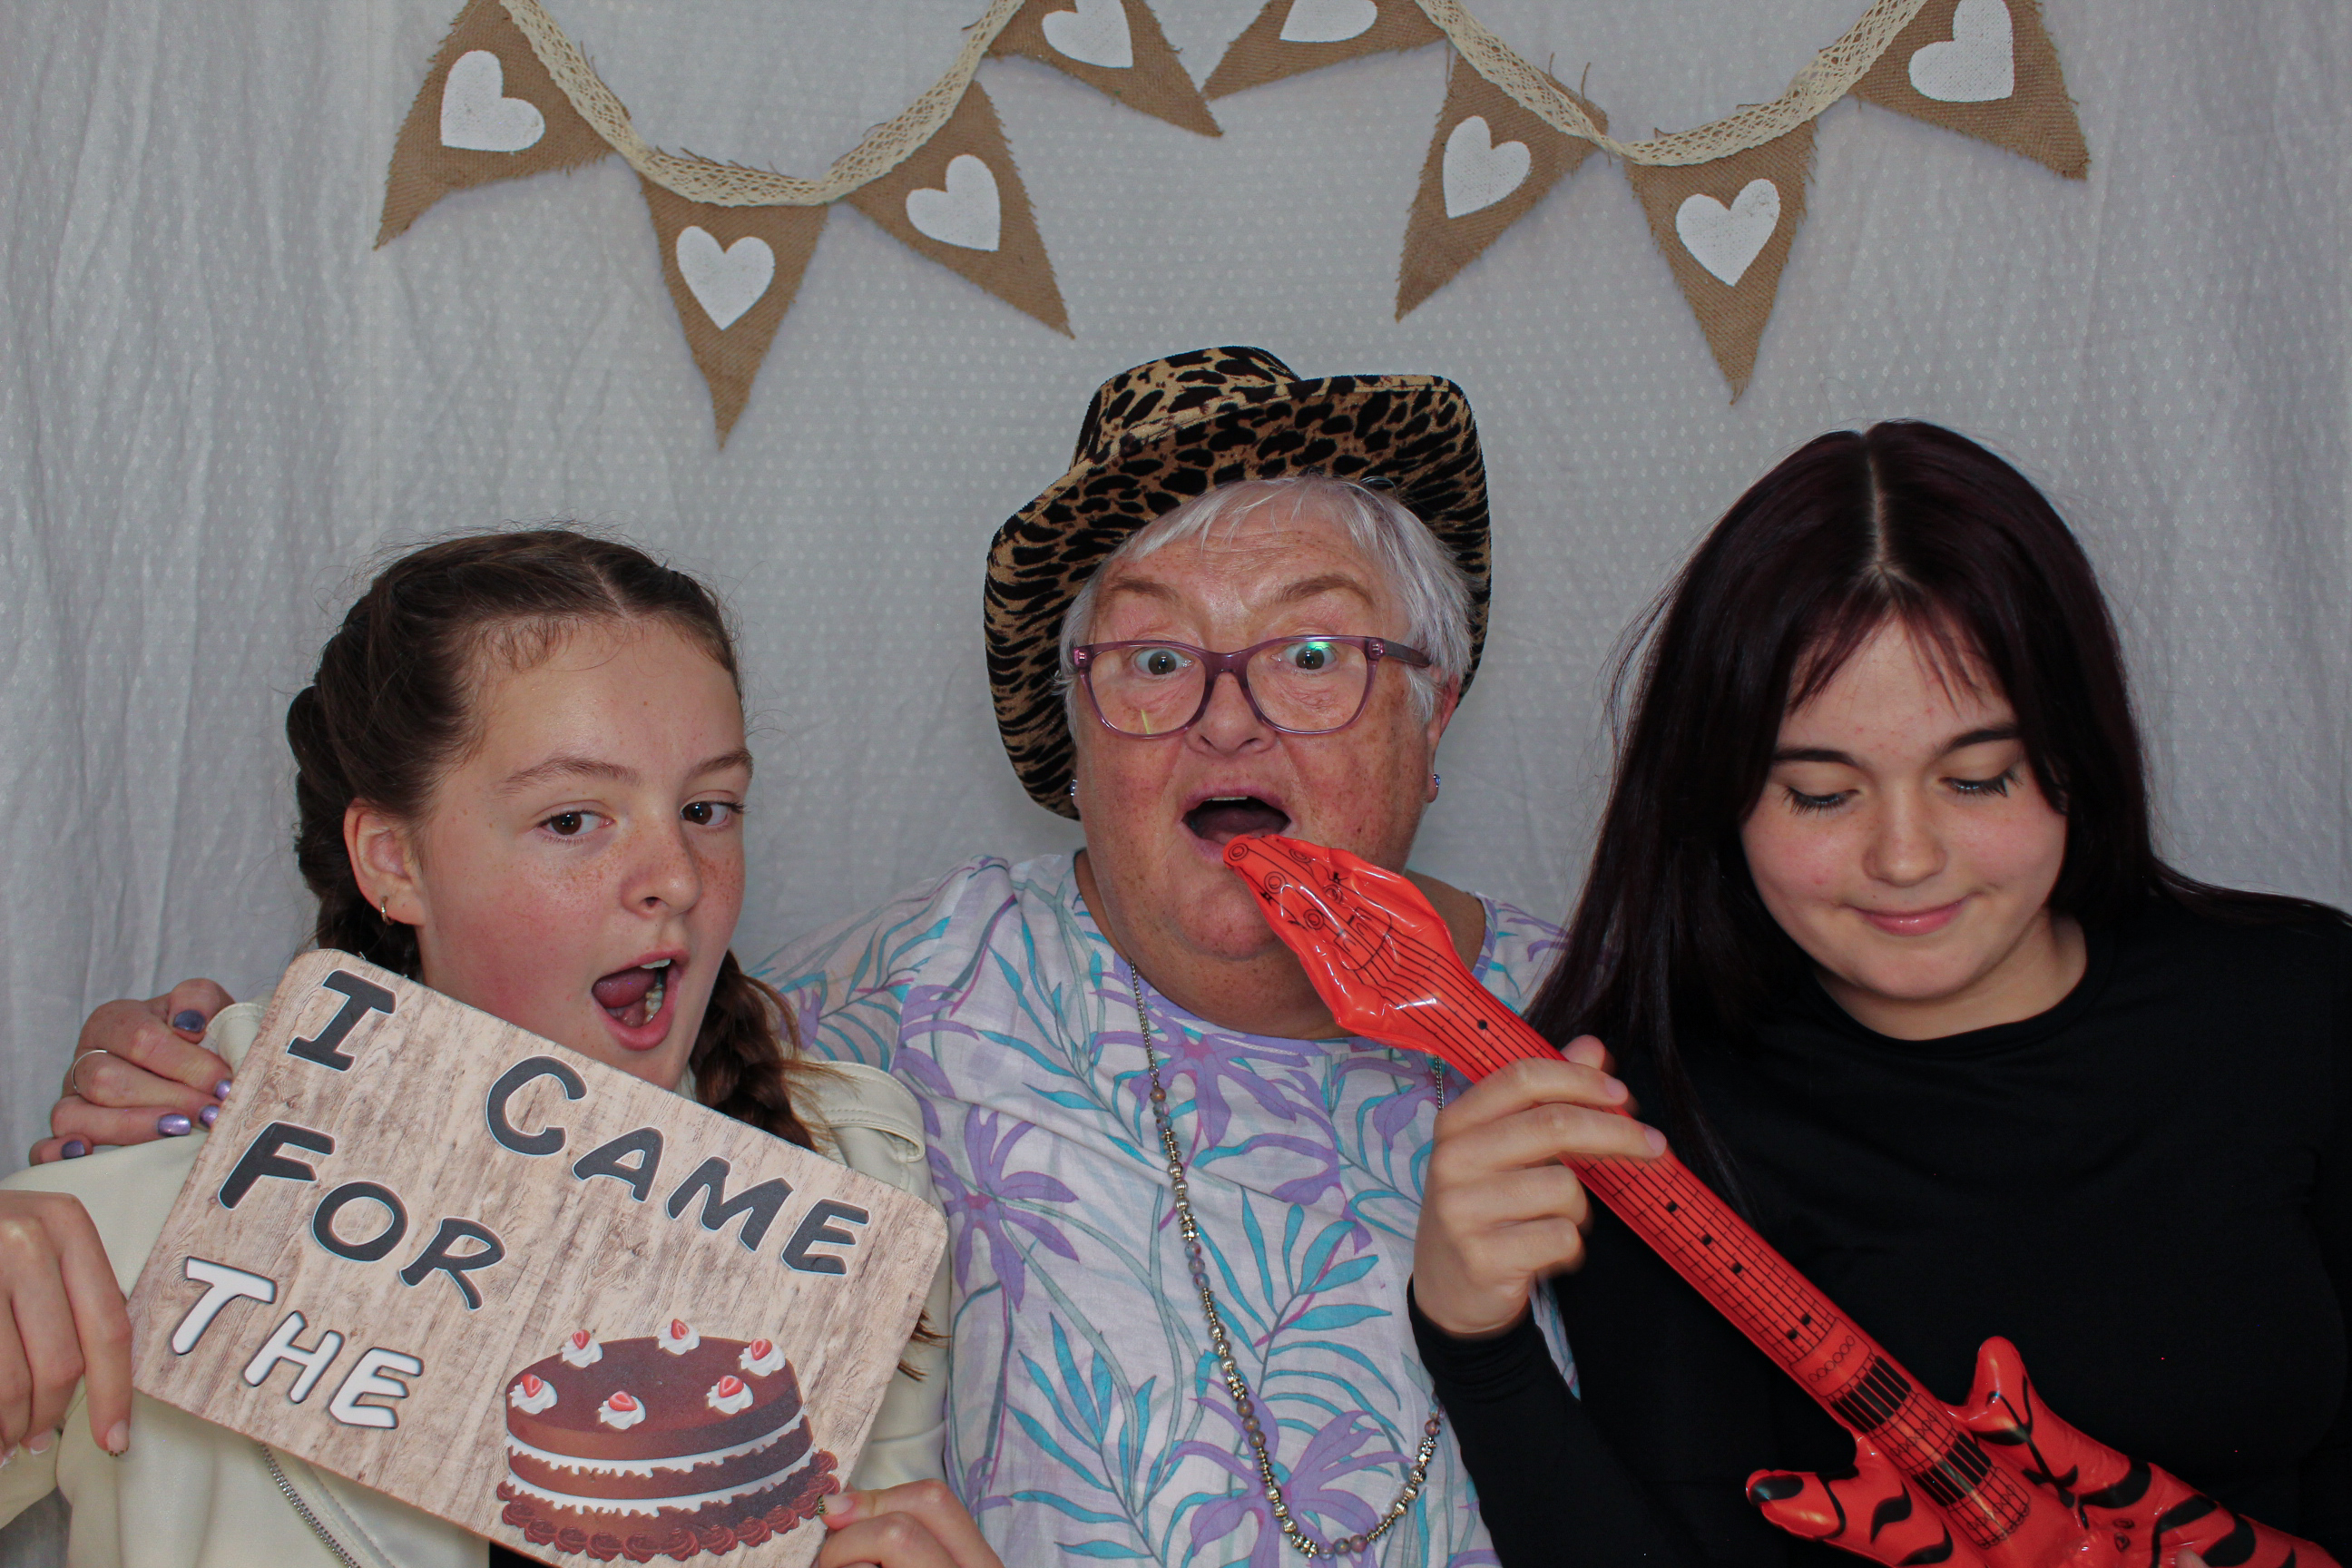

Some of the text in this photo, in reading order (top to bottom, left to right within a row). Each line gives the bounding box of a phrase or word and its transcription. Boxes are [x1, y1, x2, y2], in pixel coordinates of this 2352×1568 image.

[216, 1121, 506, 1312] FOR
[287, 968, 871, 1277] I CAME
[170, 1256, 425, 1431] THE
